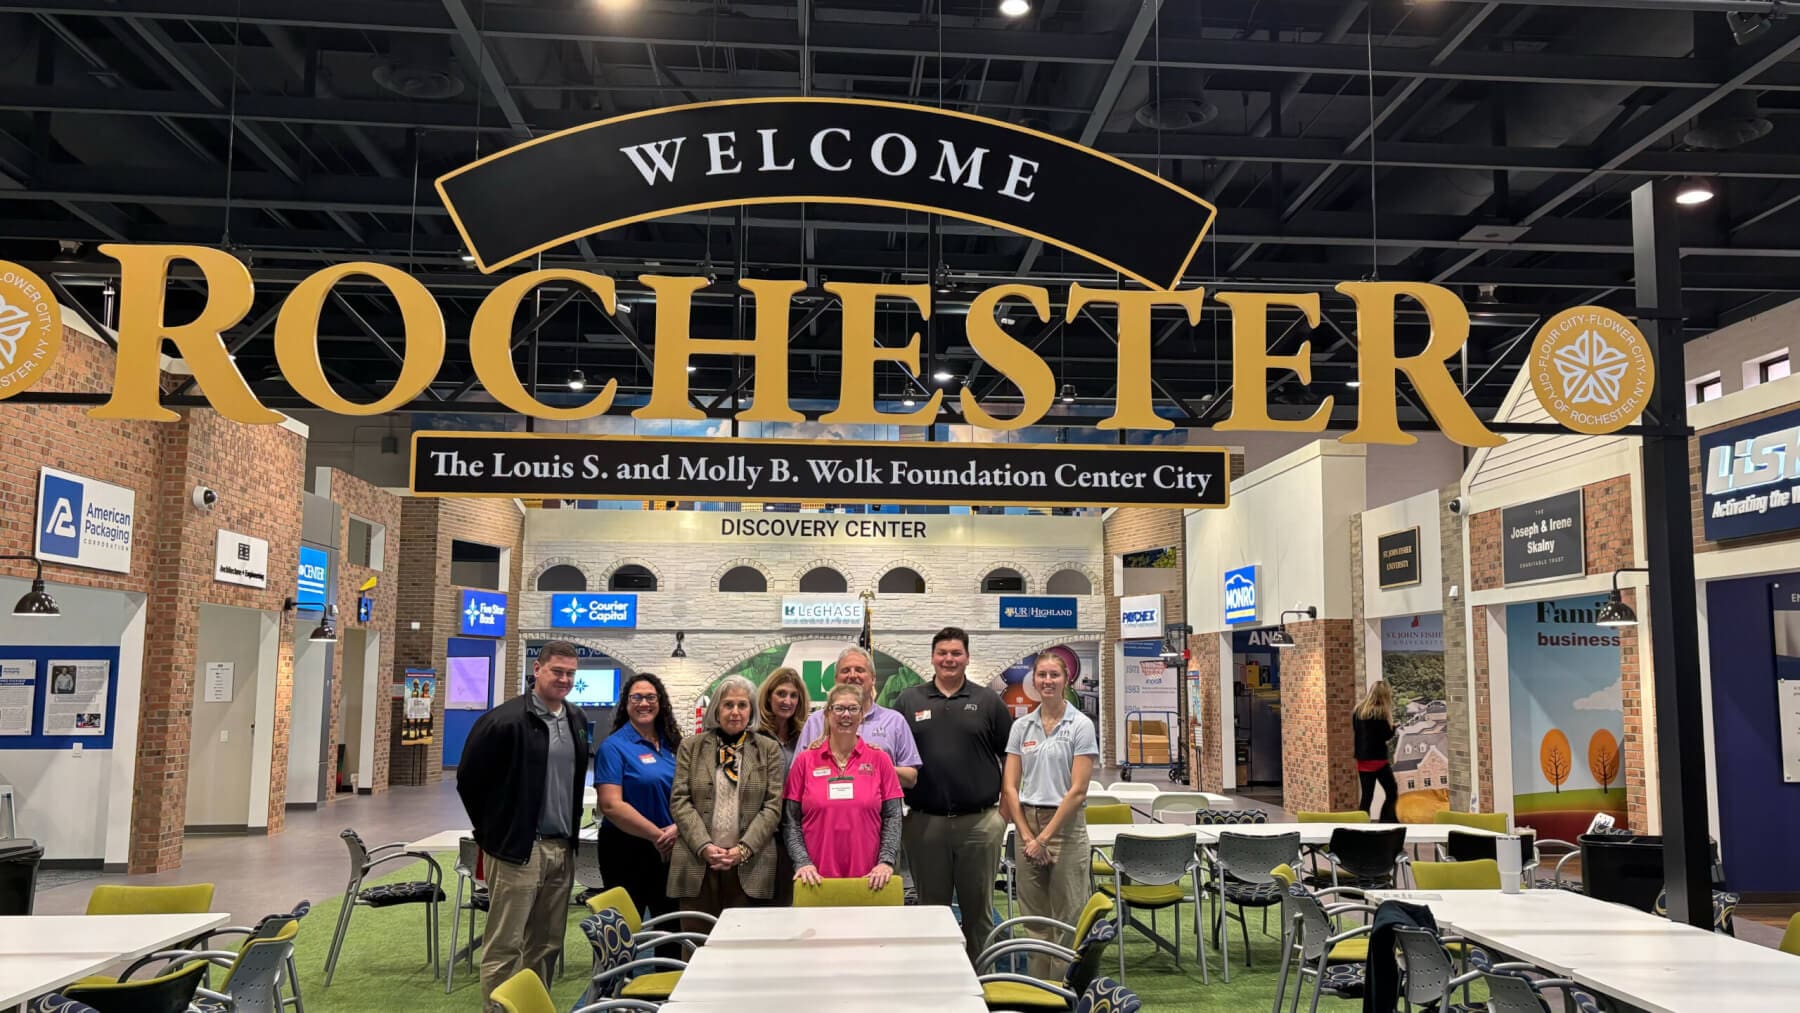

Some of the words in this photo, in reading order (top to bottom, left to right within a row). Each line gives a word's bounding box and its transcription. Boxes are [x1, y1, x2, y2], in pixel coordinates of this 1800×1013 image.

[618, 127, 1041, 203] WELCOME
[88, 242, 1508, 448] ROCHESTER
[1538, 328, 1561, 368] FLOUR
[1559, 313, 1586, 332] CITY
[1589, 314, 1636, 346] FLOWER
[1631, 345, 1647, 373] CITY
[1539, 373, 1558, 400] CITY
[1553, 399, 1570, 414] OF
[1633, 377, 1647, 398] NY
[429, 450, 484, 478] The
[490, 452, 575, 479] Louis
[581, 454, 610, 481] S.
[616, 454, 671, 481] and
[678, 455, 764, 490] Molly
[768, 457, 800, 483] B.
[805, 458, 884, 485] Wolk
[888, 460, 1048, 488] Foundation
[1054, 462, 1147, 490] Center
[1152, 463, 1213, 497] City
[86, 502, 131, 527] American
[1535, 508, 1545, 516] THE
[1711, 491, 1769, 519] Activating
[1769, 489, 1791, 509] the
[84, 519, 130, 545] Packaging
[721, 518, 840, 537] DISCOVERY
[845, 519, 927, 538] CENTER
[1510, 522, 1539, 540] Joseph
[1540, 519, 1548, 533] &
[1549, 516, 1573, 532] Irene
[83, 538, 129, 552] CORPORATION
[1526, 538, 1556, 554] Skalny
[588, 599, 630, 612] Courier
[1225, 585, 1256, 610] MONRO
[479, 614, 495, 625] Bank
[588, 610, 628, 623] Capital
[1014, 607, 1028, 616] UR
[1537, 631, 1622, 647] business
